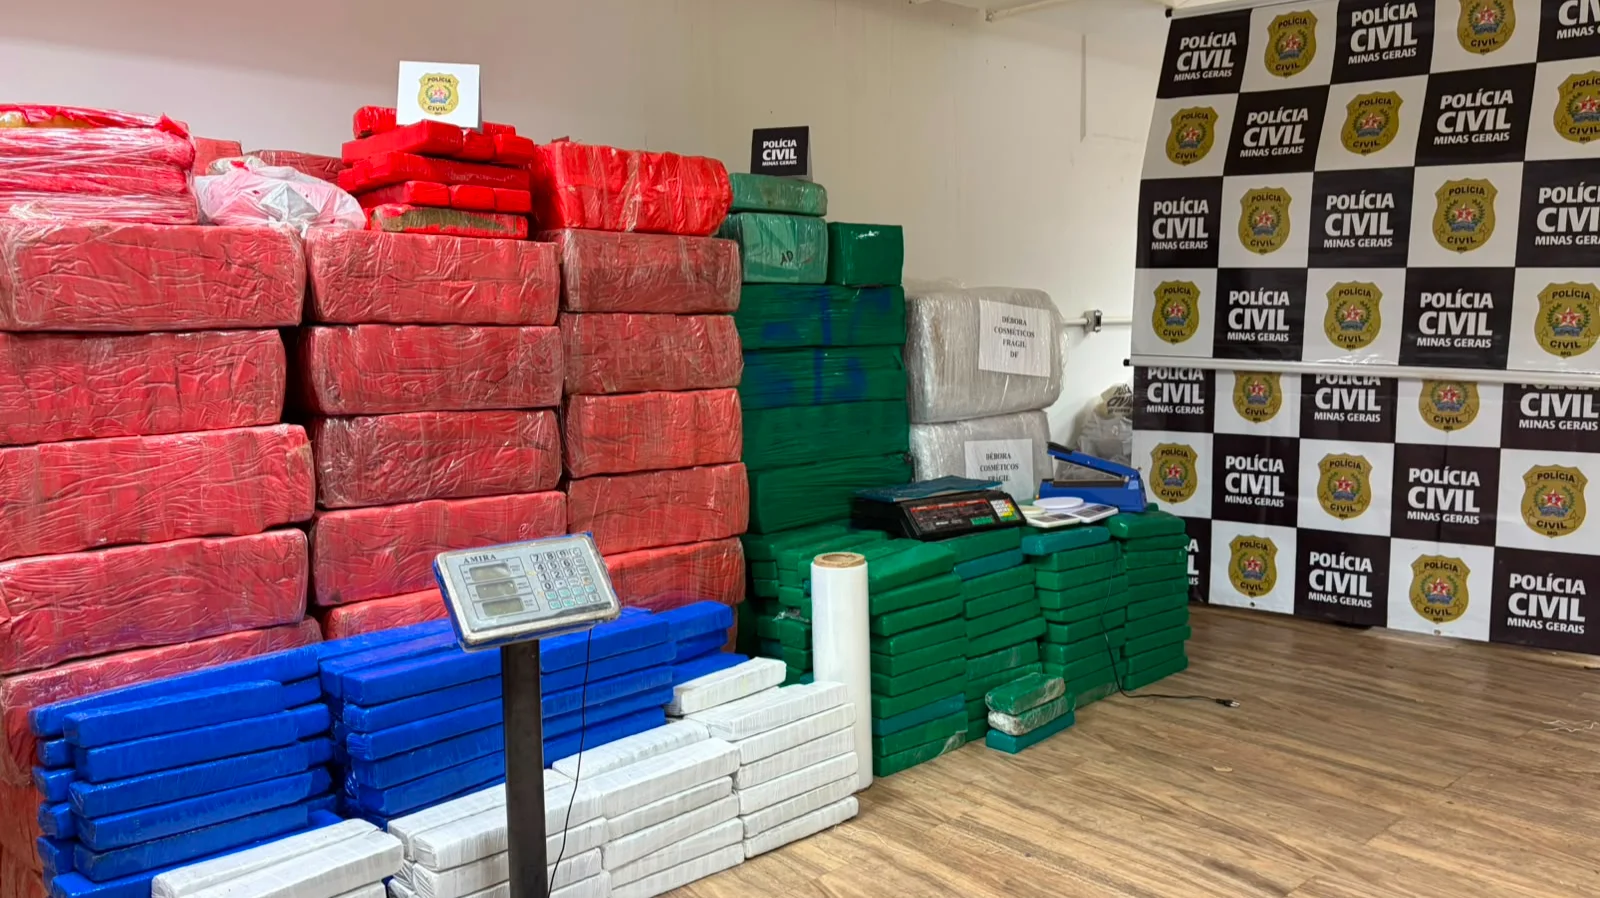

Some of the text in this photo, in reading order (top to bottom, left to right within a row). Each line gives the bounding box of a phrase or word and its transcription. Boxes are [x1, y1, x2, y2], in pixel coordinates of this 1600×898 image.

[1351, 3, 1418, 27] POLÍCIA
[1278, 16, 1308, 28] POLÍCIA
[1351, 22, 1418, 52] CIVIL
[1556, 26, 1594, 39] MINAS
[1180, 30, 1237, 50] POLÍCIA
[1471, 38, 1498, 47] CIVIL
[1176, 49, 1234, 72] CIVIL
[1348, 48, 1416, 65] MINAS GERAIS
[1276, 62, 1300, 71] CIVIL
[1174, 69, 1232, 81] MINAS GERAIS
[1359, 98, 1392, 107] POLÍCIA
[1440, 89, 1514, 110] POLÍCIA
[1181, 112, 1209, 121] POLÍCIA
[1246, 106, 1308, 125] POLÍCIA
[1436, 108, 1512, 134] CIVIL
[1243, 124, 1306, 148] CIVIL
[1569, 126, 1600, 134] CIVIL
[763, 138, 797, 148] POLÍCIA
[1433, 132, 1510, 145] MINAS GERAIS
[763, 148, 797, 160] CIVIL
[1240, 146, 1303, 158] MINAS GERAIS
[1449, 185, 1485, 196] POLÍCIA
[1252, 192, 1281, 202] POLÍCIA
[1326, 190, 1394, 210] POLÍCIA
[1153, 197, 1209, 215] POLÍCIA
[1152, 217, 1208, 239] CIVIL
[1325, 212, 1393, 236] CIVIL
[1151, 240, 1208, 250] MINAS GERAIS
[1250, 239, 1275, 247] CIVIL
[1324, 238, 1392, 248] MINAS GERAIS
[1535, 236, 1572, 246] MINAS
[1164, 287, 1191, 296] POLÍCIA
[1229, 288, 1290, 305] POLÍCIA
[1339, 288, 1371, 297] POLÍCIA
[1552, 290, 1591, 300] POLÍCIA
[1420, 289, 1494, 309] POLÍCIA
[1228, 308, 1290, 331] CIVIL
[1419, 311, 1493, 336] CIVIL
[994, 327, 1035, 338] COSMÉTICOS
[1227, 332, 1289, 342] MINAS GERAIS
[1417, 337, 1491, 348] MINAS GERAIS
[1550, 340, 1581, 349] CIVIL
[1147, 382, 1204, 404] CIVIL
[1315, 387, 1381, 411] CIVIL
[1147, 405, 1204, 414] MINAS GERAIS
[1520, 392, 1599, 418] CIVIL
[1245, 408, 1268, 416] CIVIL
[1314, 412, 1381, 422] MINAS GERAIS
[1433, 415, 1462, 423] CIVIL
[1519, 420, 1598, 431] MINAS GERAIS
[1161, 448, 1189, 458] POLÍCIA
[1226, 454, 1285, 473] POLÍCIA
[1329, 460, 1361, 470] POLÍCIA
[1408, 466, 1480, 486] POLÍCIA
[1537, 471, 1575, 483] POLÍCIA
[1225, 473, 1285, 497] CIVIL
[1161, 489, 1184, 497] CIVIL
[1225, 495, 1284, 508] MINAS GERAIS
[1408, 487, 1480, 512] CIVIL
[1330, 504, 1356, 512] CIVIL
[1407, 511, 1479, 524] MINAS GERAIS
[1537, 520, 1567, 529] CIVIL
[1239, 540, 1269, 550] POLÍCIA
[464, 554, 496, 564] AMIRA
[1310, 552, 1373, 572] POLÍCIA
[1424, 561, 1459, 572] POLÍCIA
[1240, 582, 1264, 591] CIVIL
[1309, 570, 1373, 597] CIVIL
[1509, 573, 1586, 595] POLÍCIA
[1308, 592, 1372, 608] MINAS GERAIS
[1424, 606, 1452, 616] CIVIL
[1508, 592, 1585, 622] CIVIL
[1507, 618, 1585, 634] MINAS GERAIS
